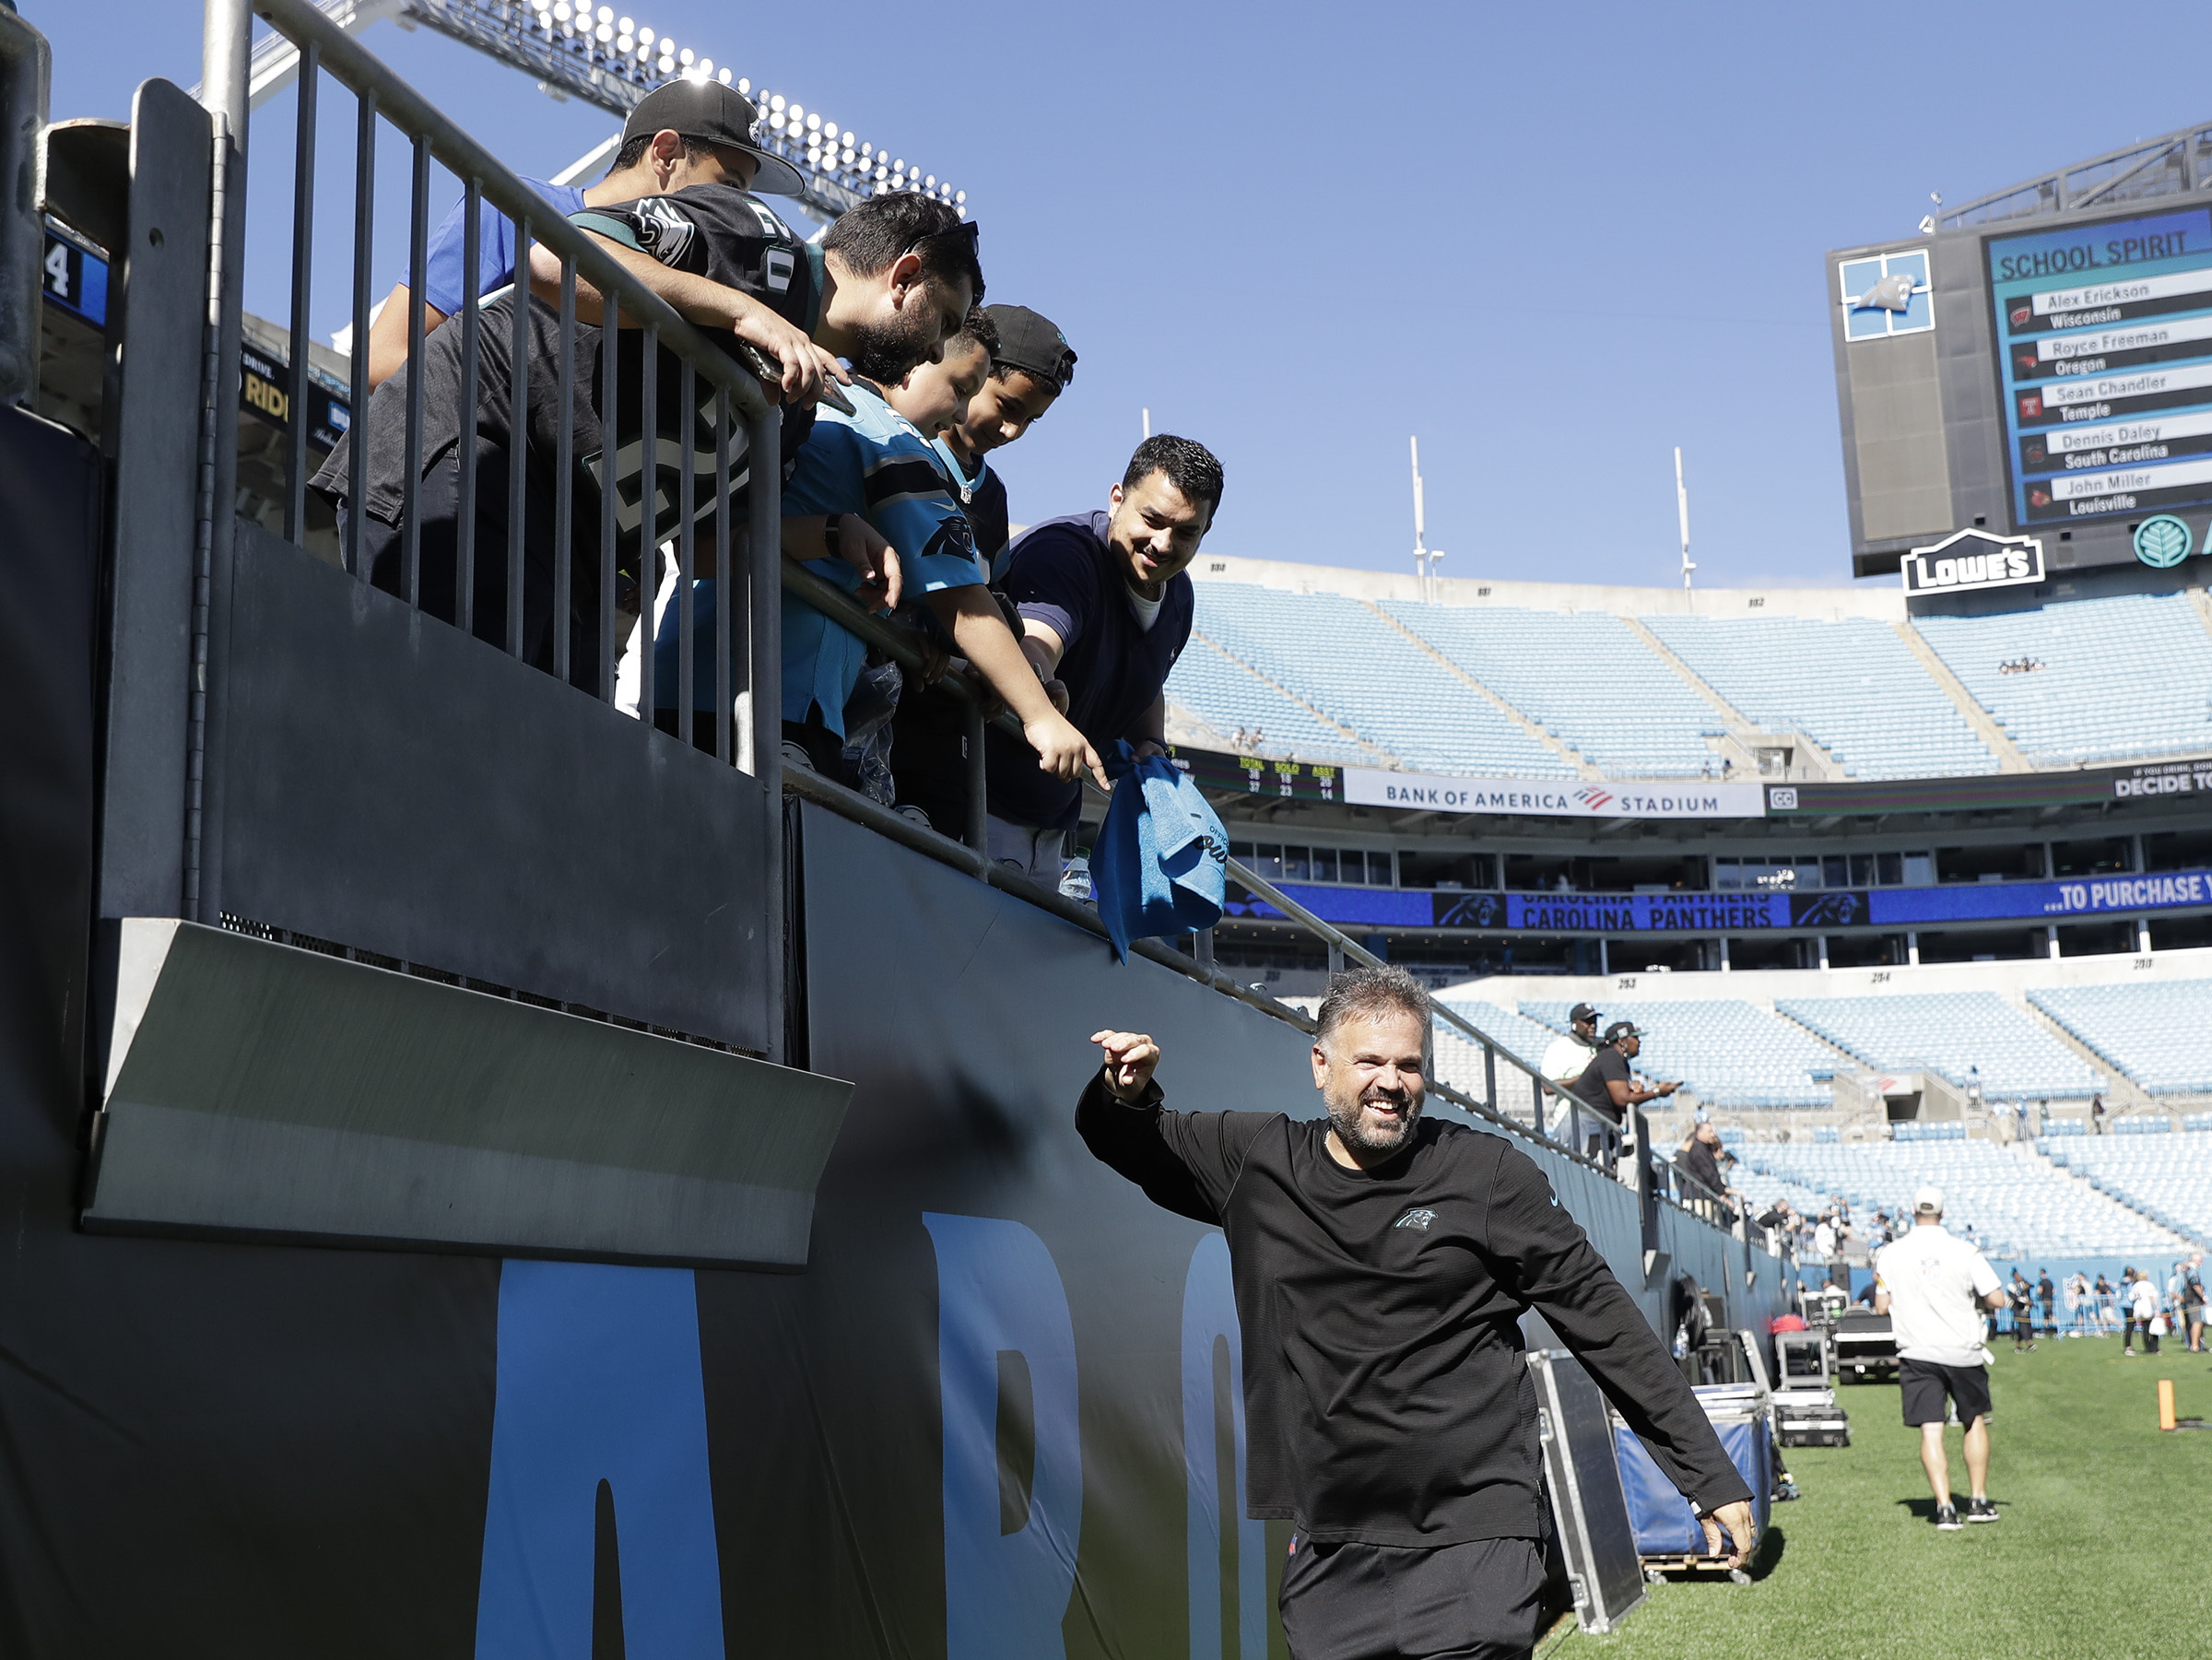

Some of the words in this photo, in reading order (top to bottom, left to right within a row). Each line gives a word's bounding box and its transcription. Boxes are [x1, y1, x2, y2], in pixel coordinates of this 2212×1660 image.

[2000, 245, 2100, 280] SCHOOL
[2107, 231, 2187, 265] SPIRIT
[2047, 295, 2079, 309] Alex
[2084, 285, 2149, 303] Erickson
[2050, 307, 2122, 329] Wisconsin
[2053, 338, 2098, 357] Royce
[2101, 330, 2168, 347] Freeman
[2054, 358, 2106, 376] Oregon
[2056, 385, 2094, 401] Sean
[2098, 376, 2166, 394] Chandler
[2059, 403, 2112, 422] Temple
[2062, 431, 2113, 450] Dennis
[2118, 425, 2161, 441] Daley
[2065, 451, 2107, 469] South
[2109, 444, 2169, 464] Carolina
[2067, 479, 2103, 495] John
[2107, 473, 2151, 489] Miller
[2069, 494, 2136, 515] Louisville
[1916, 547, 2030, 588] LOWE'S
[2115, 773, 2193, 796] DECIDE
[1386, 786, 1439, 805] BANK
[1444, 791, 1468, 806] OF
[1475, 792, 1568, 809] AMERICA
[1621, 796, 1718, 812] STADIUM
[2090, 875, 2204, 909] PURCHASE
[1524, 908, 1635, 930] CAROLINA
[1650, 907, 1771, 929] PANTHERS
